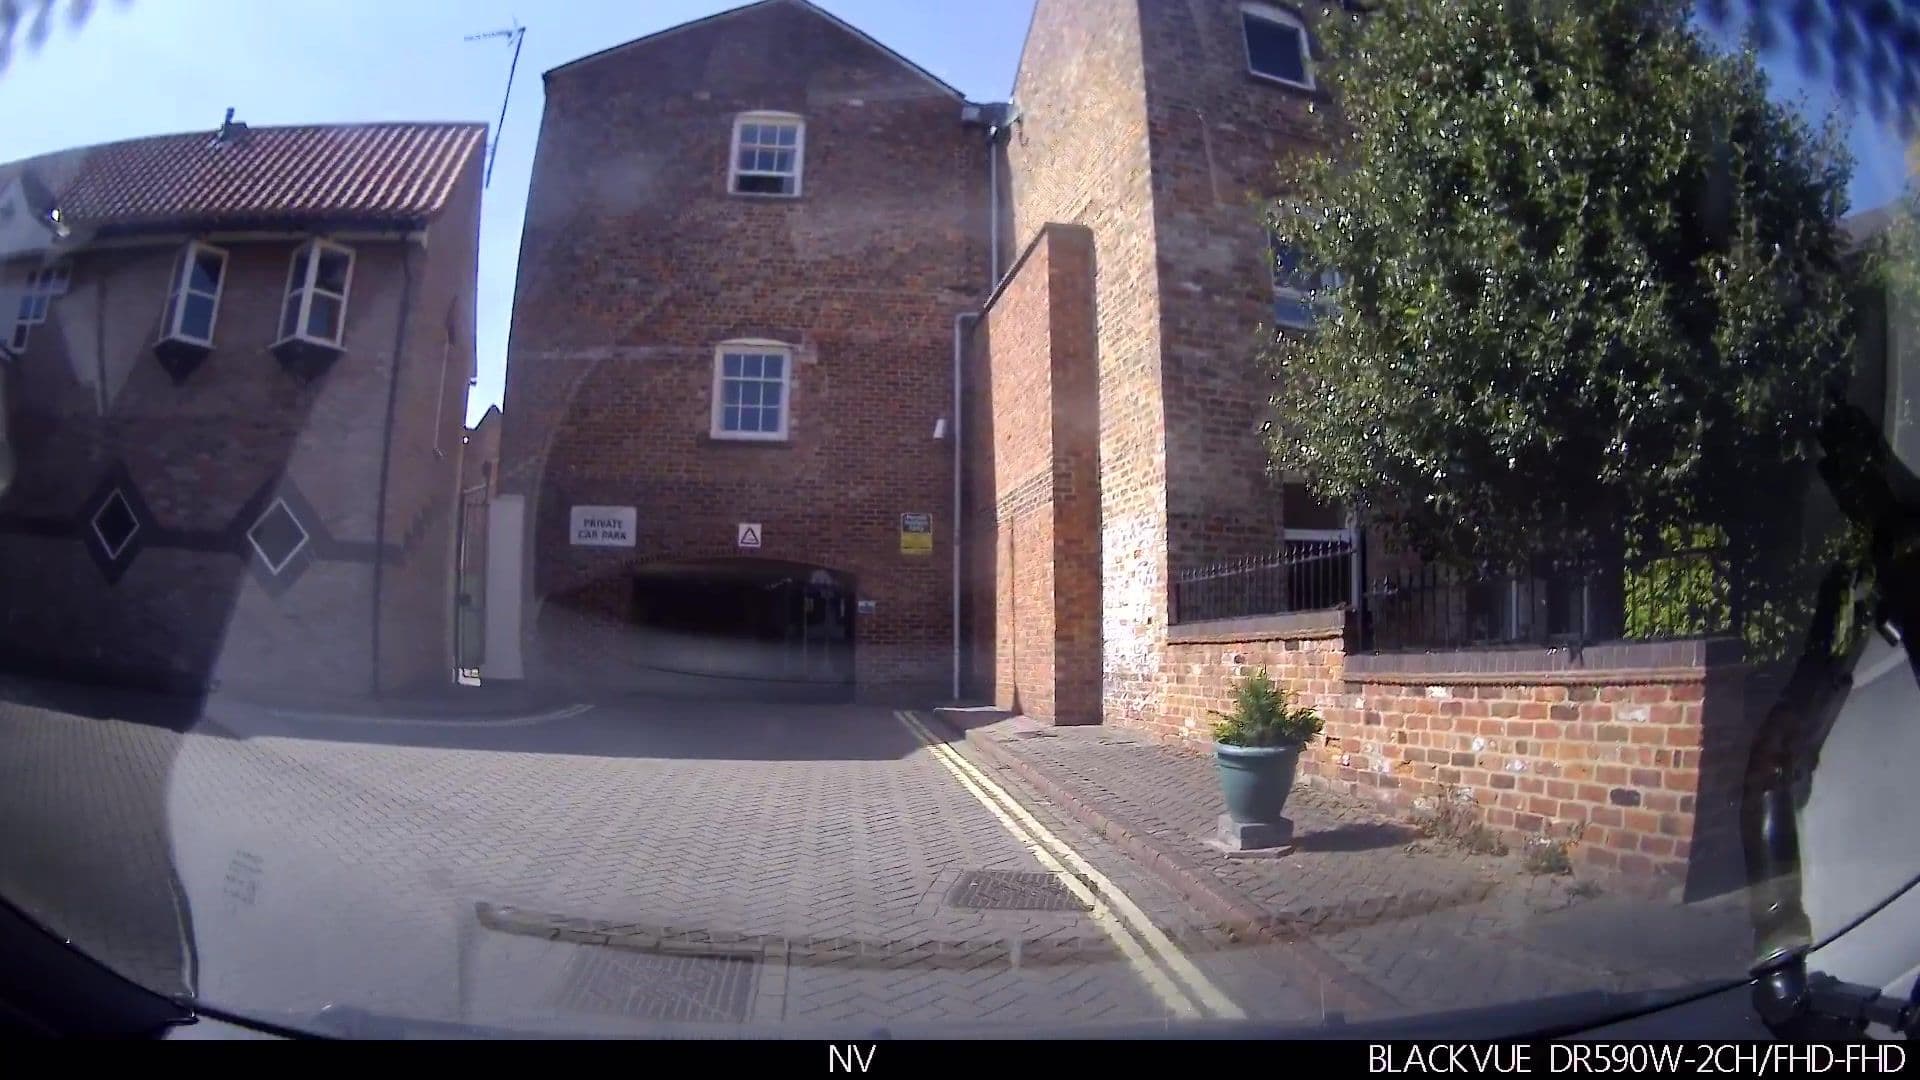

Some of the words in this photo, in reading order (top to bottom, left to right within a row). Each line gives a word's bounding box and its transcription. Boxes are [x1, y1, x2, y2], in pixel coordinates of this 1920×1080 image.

[583, 519, 624, 529] PRIVATE
[578, 530, 598, 539] CAR
[602, 531, 627, 540] PARK
